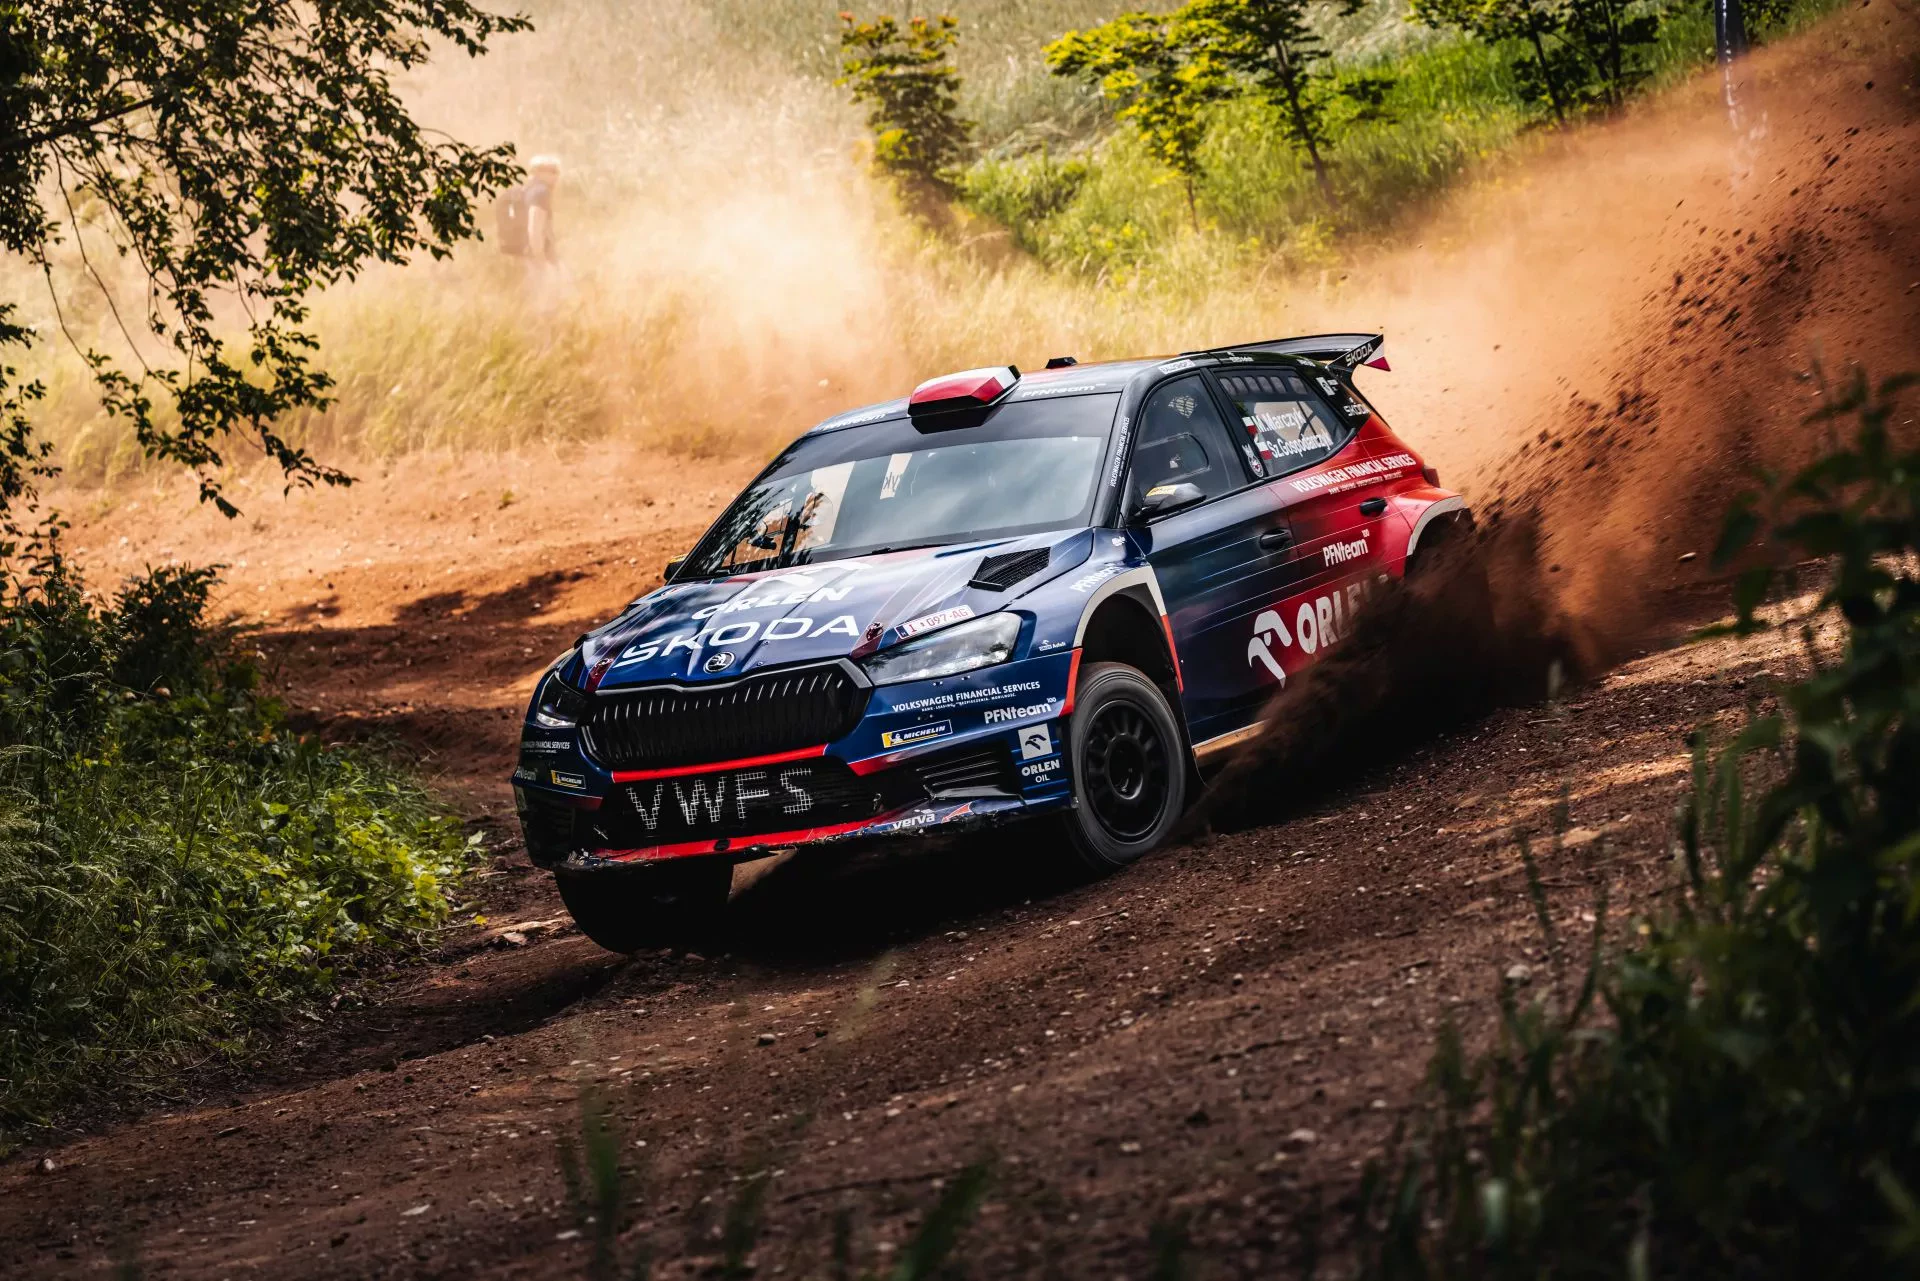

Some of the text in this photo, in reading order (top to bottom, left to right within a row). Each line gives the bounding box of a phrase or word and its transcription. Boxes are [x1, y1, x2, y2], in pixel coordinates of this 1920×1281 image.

[1289, 469, 1348, 493] VOLKSWAGEN
[1347, 459, 1385, 478] FINANCIAL
[1381, 453, 1417, 470] SERVICES
[1322, 539, 1369, 567] PFNteam
[691, 587, 856, 620] ORLEN
[892, 681, 1041, 712] VOLKSWAGEN FINANCIAL SERVICES
[984, 702, 1053, 725] PFNteam
[903, 725, 946, 740] MICHELIN
[1021, 759, 1061, 777] ORLEN
[1035, 775, 1050, 783] OIL
[626, 767, 814, 830] VWFS
[892, 812, 936, 831] verva
